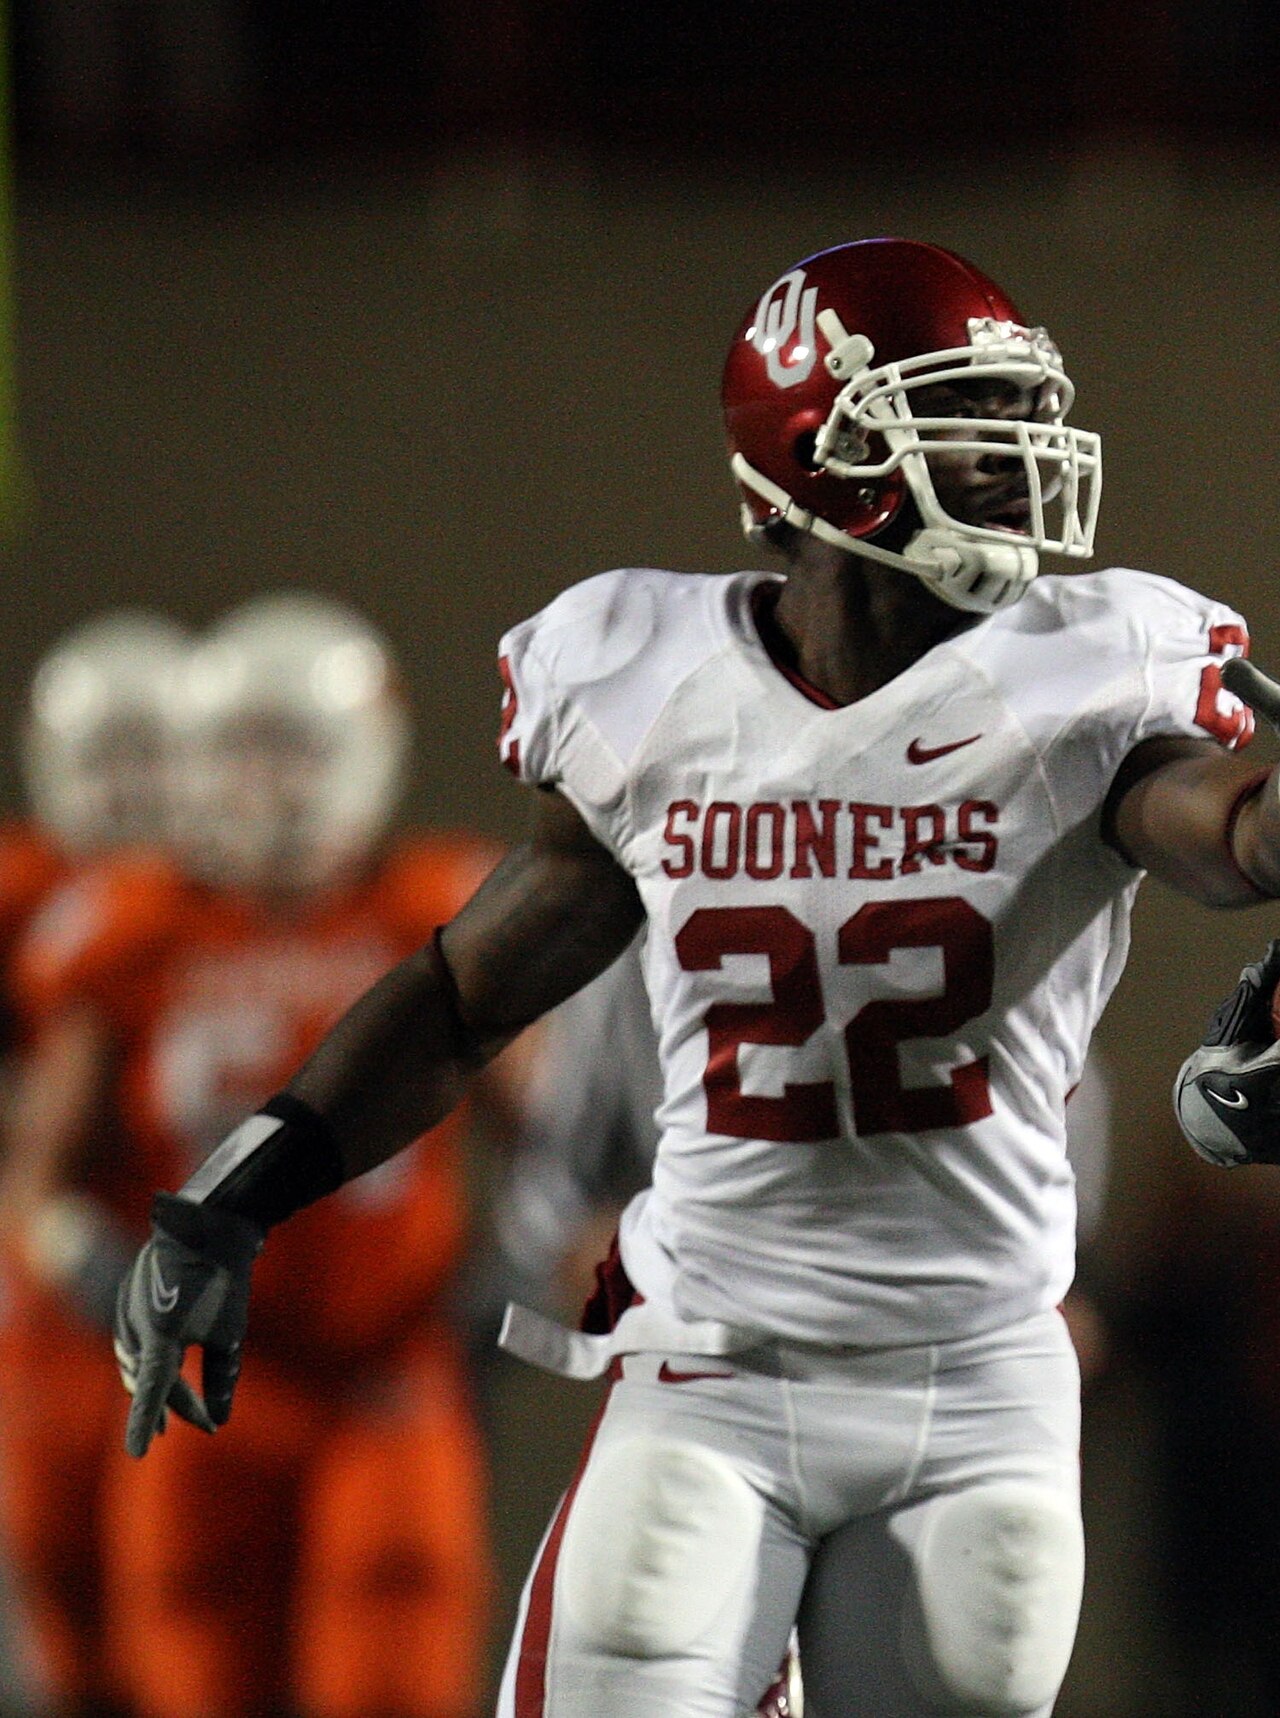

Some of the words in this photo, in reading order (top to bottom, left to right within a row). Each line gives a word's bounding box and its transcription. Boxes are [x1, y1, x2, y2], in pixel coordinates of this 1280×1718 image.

[752, 268, 818, 390] OU
[661, 799, 1000, 880] SOONERS
[674, 896, 995, 1143] 22
